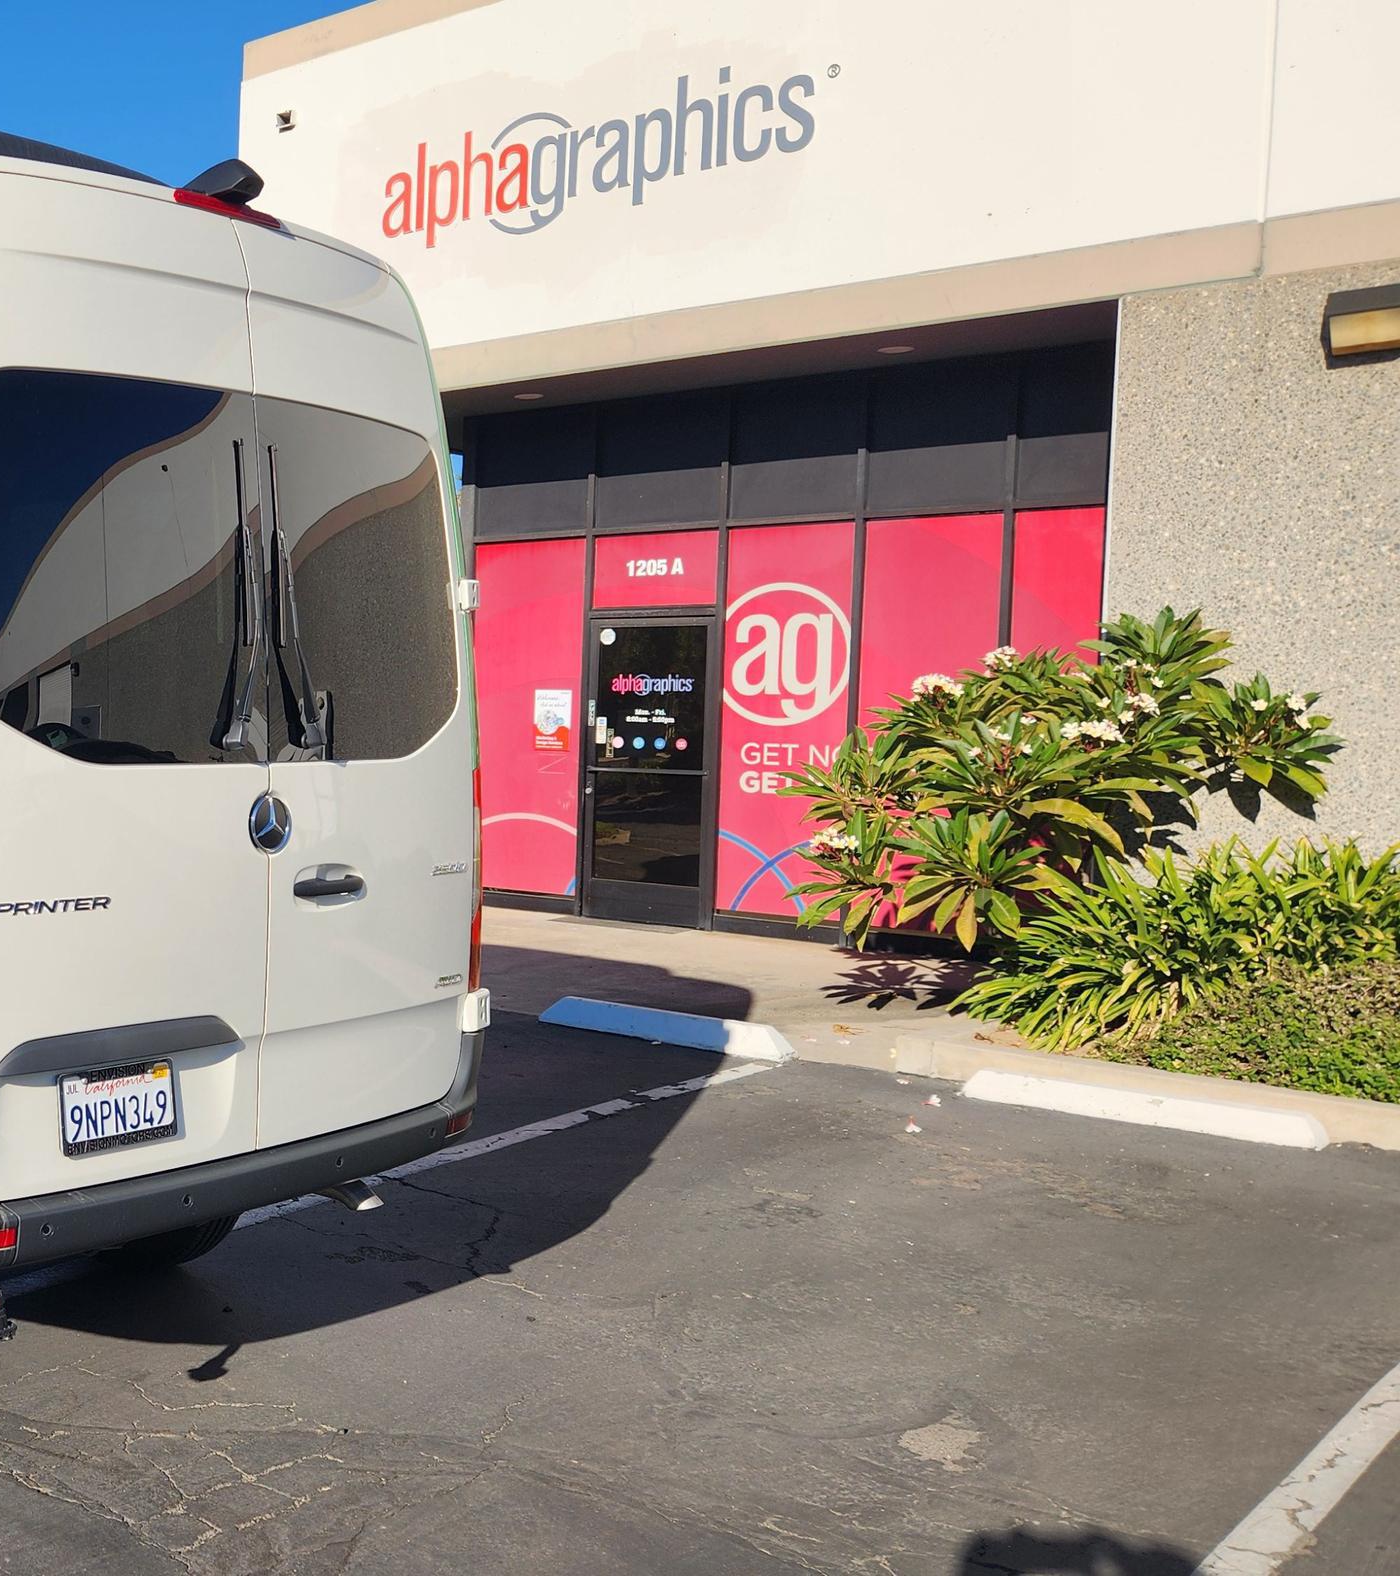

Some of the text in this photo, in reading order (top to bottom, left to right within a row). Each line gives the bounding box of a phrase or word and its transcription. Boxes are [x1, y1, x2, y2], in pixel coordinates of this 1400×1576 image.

[382, 65, 816, 250] alphagraphics
[625, 556, 685, 577] 1205 A
[611, 673, 693, 696] alphagraphics
[740, 741, 799, 767] GET
[89, 1063, 146, 1083] ENVISION
[66, 1083, 79, 1095] JUL
[85, 1073, 153, 1097] California
[70, 1089, 167, 1142] 9NPN349
